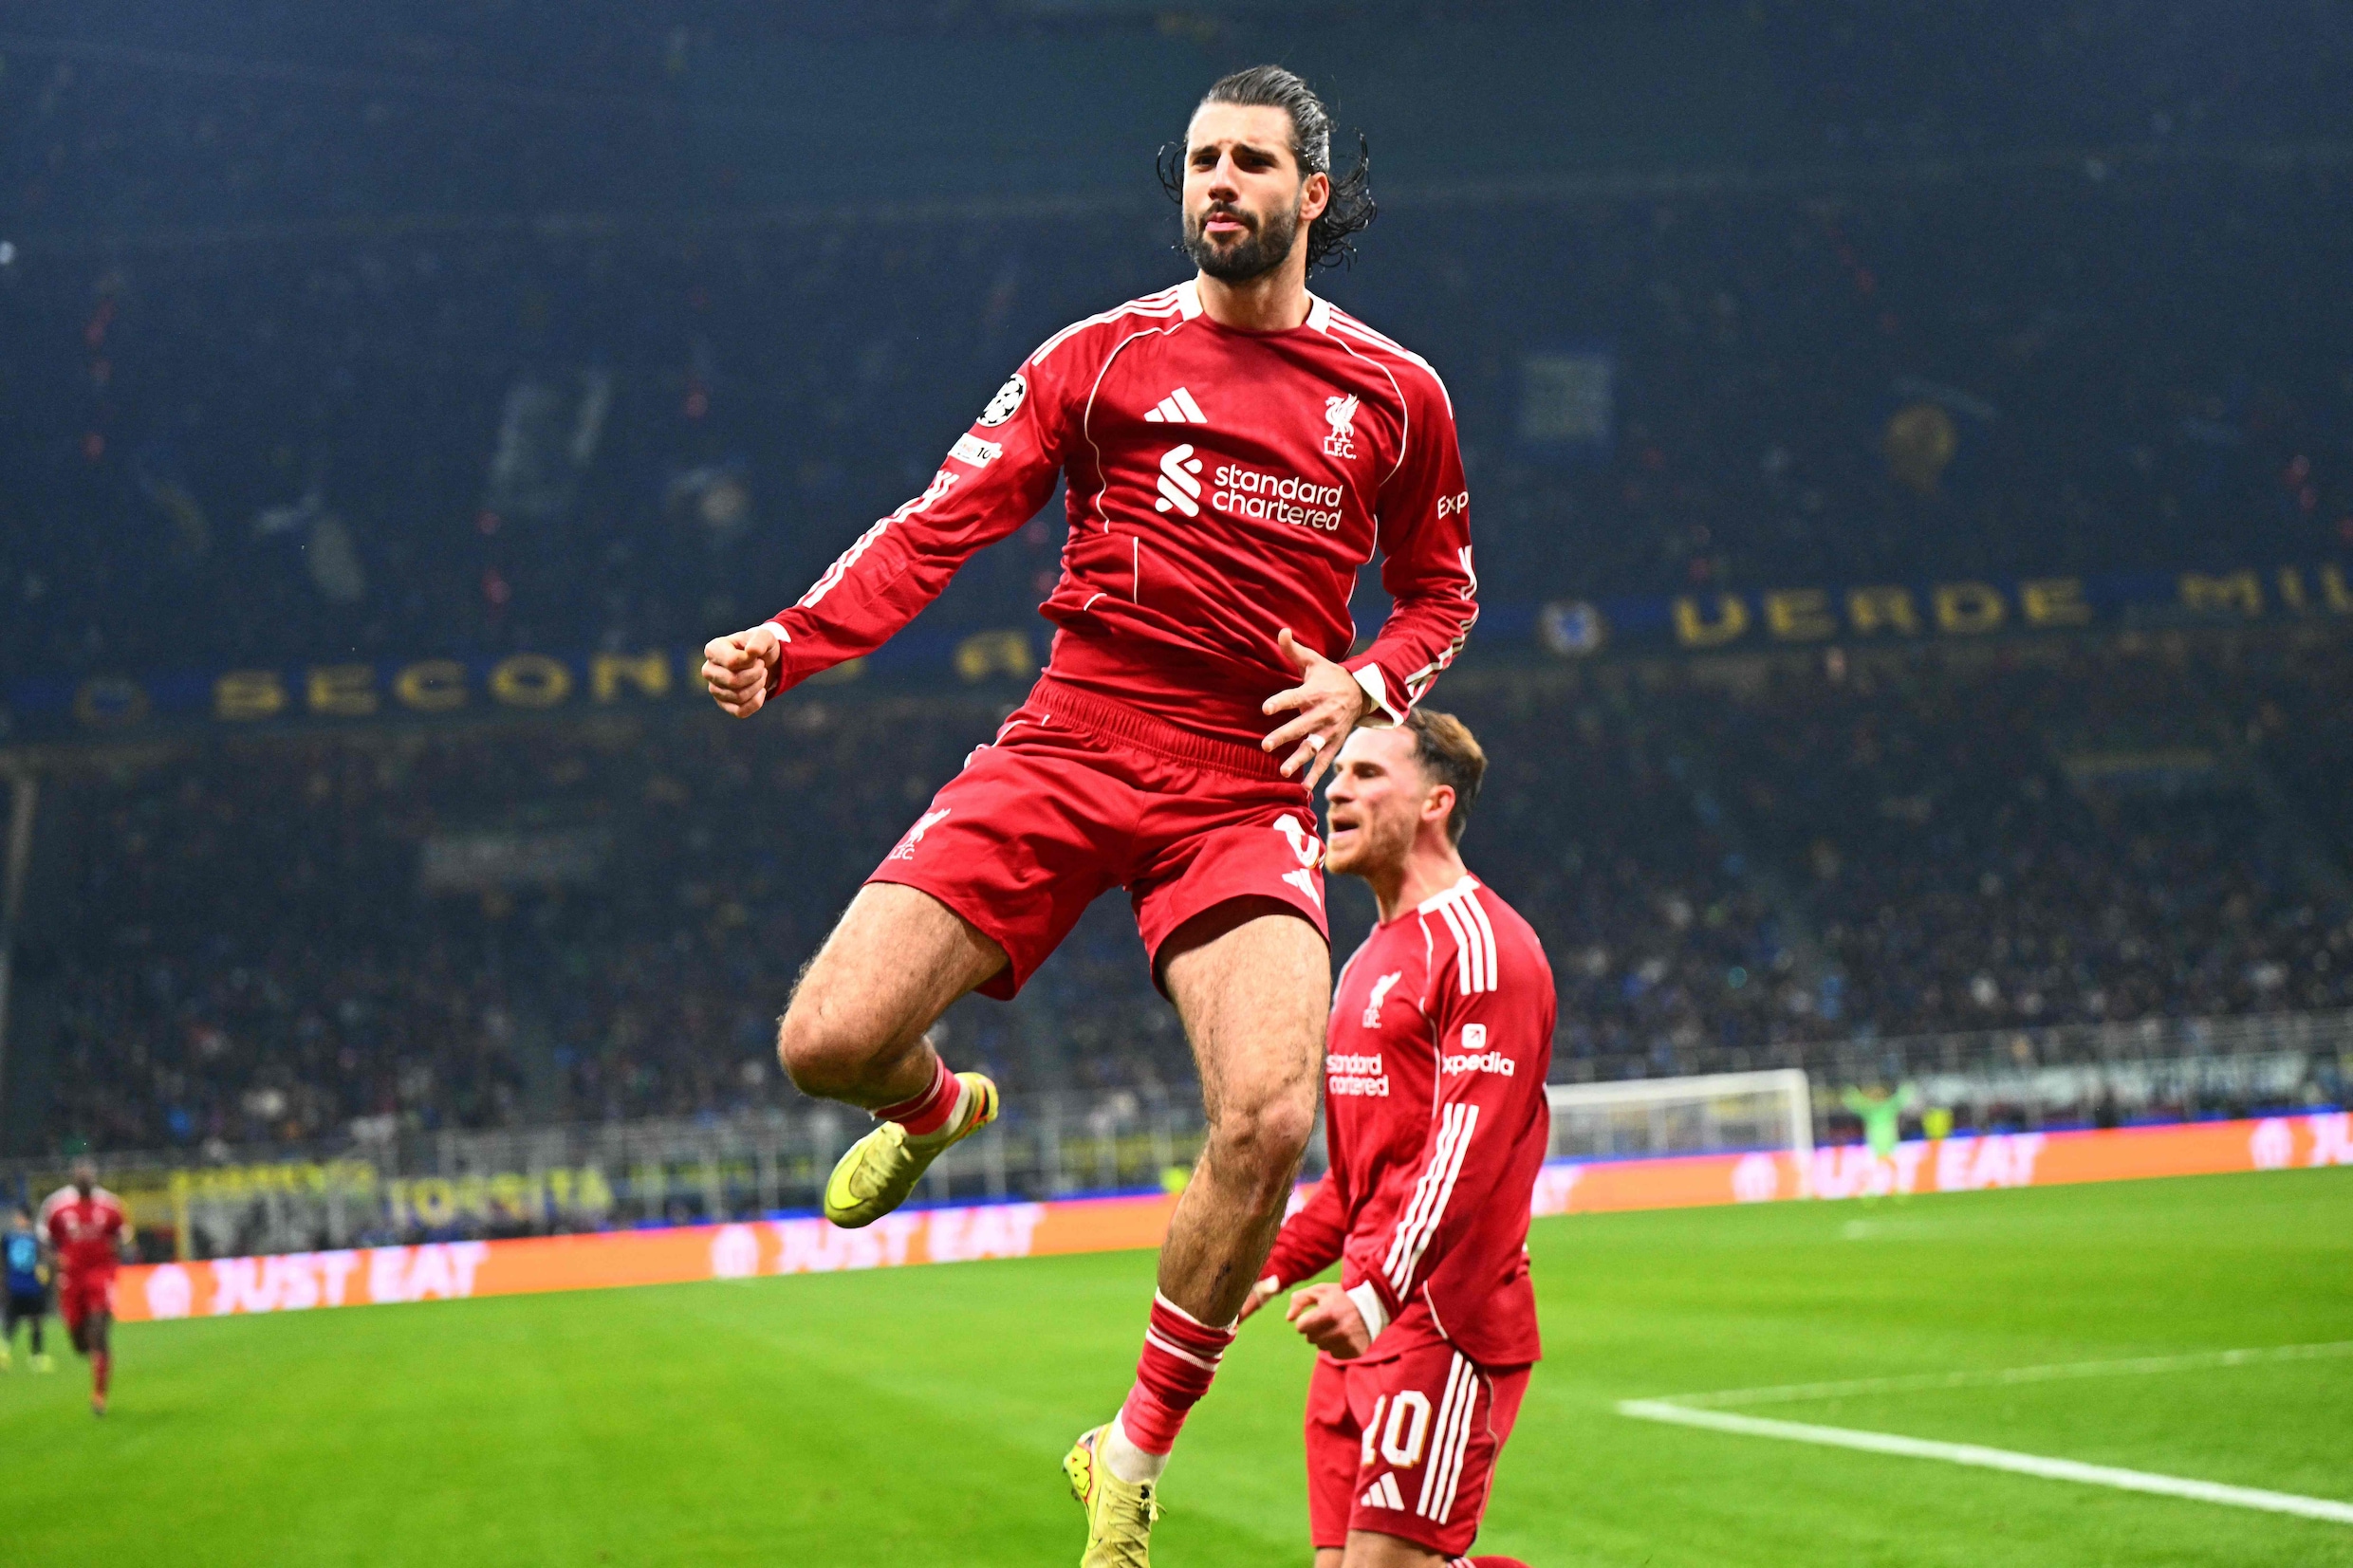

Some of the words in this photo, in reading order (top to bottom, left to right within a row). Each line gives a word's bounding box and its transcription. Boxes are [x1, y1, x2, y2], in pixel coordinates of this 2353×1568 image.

[1212, 488, 1343, 531] chartered
[1214, 463, 1343, 508] standard
[1441, 1051, 1515, 1077] xpedia
[1937, 1132, 2047, 1192] EAT
[927, 1201, 1045, 1264] EAT
[210, 1247, 361, 1317] JUST
[368, 1240, 491, 1303] EAT
